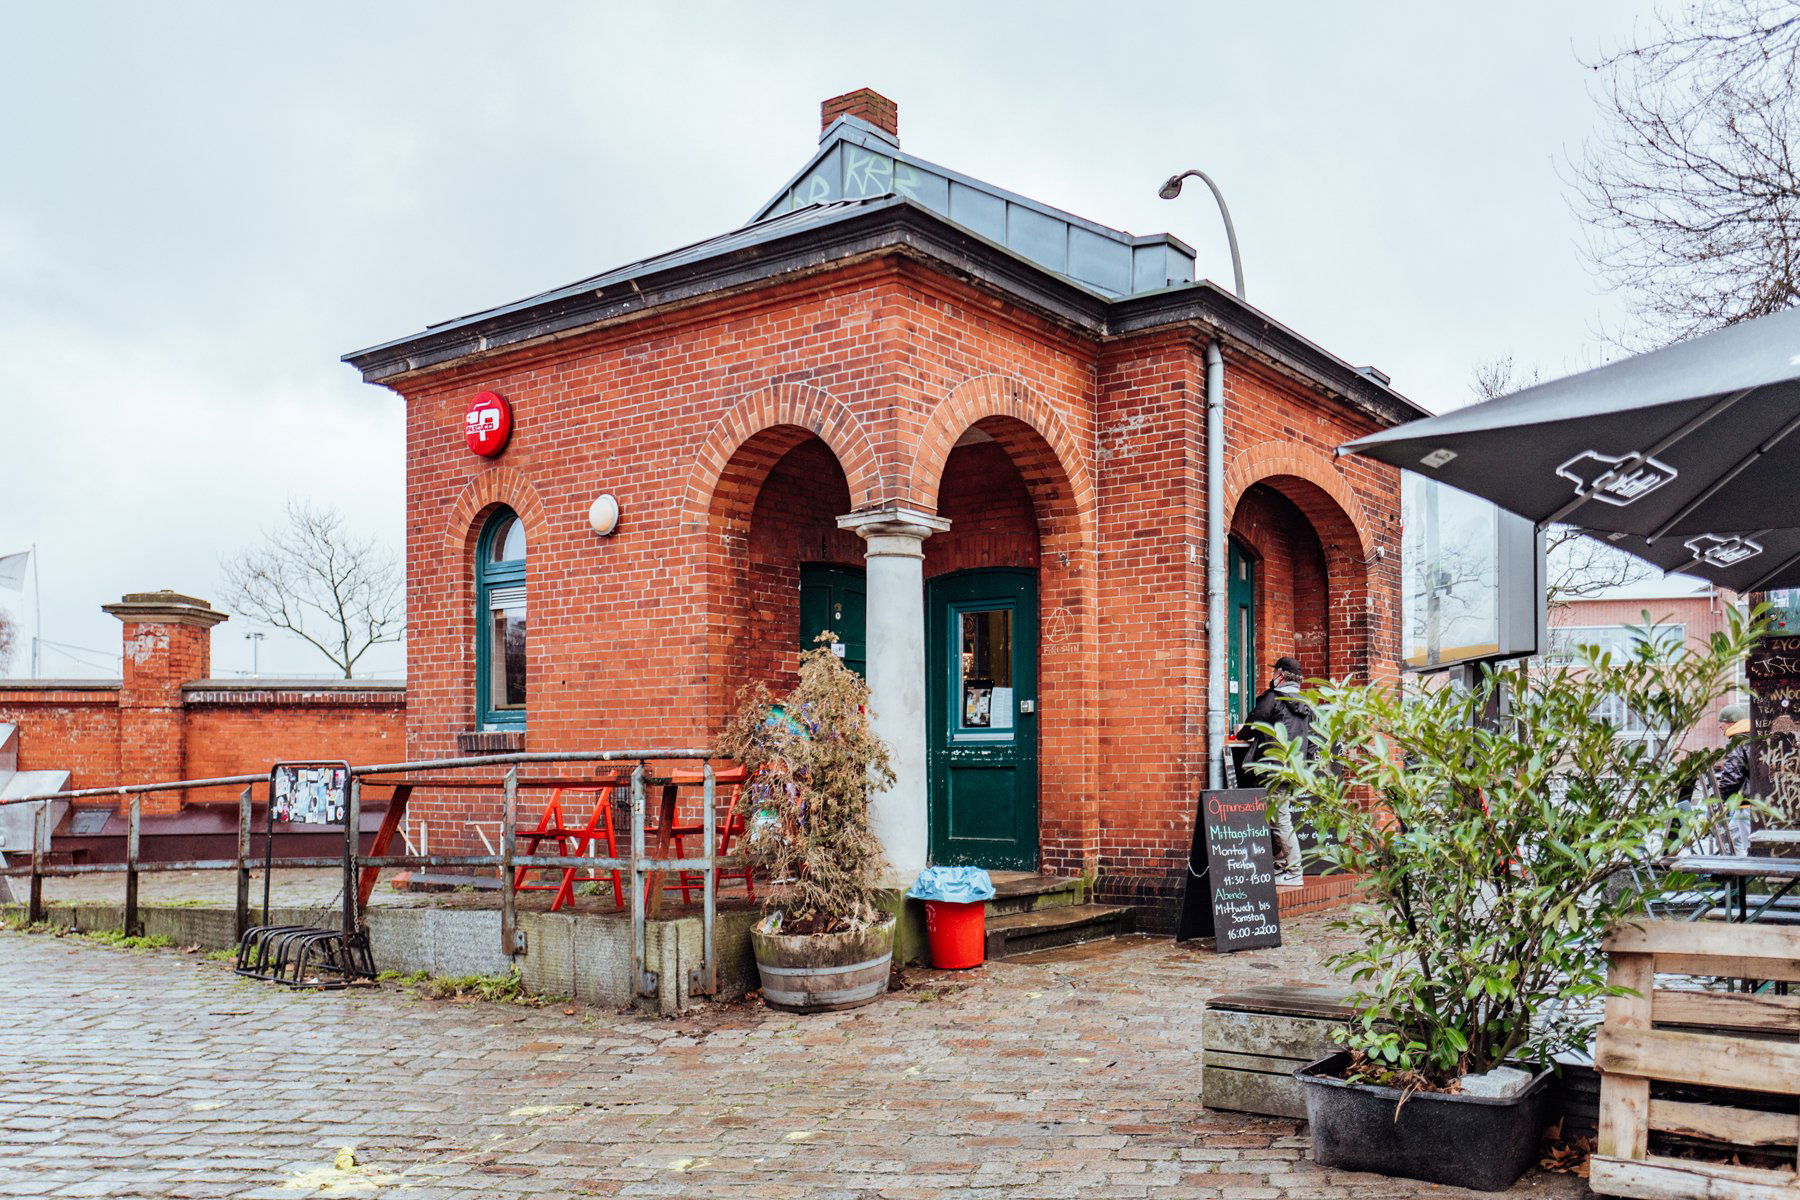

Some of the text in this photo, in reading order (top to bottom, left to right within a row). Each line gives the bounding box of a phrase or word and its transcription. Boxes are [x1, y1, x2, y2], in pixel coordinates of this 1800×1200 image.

[1210, 824, 1269, 845] Mittagstisch
[1212, 842, 1266, 861] Montag bis
[1228, 859, 1256, 875] Freitag
[1215, 888, 1248, 902] Abends
[1215, 901, 1271, 915] Mittwoch bis
[1231, 913, 1266, 928] Samstag
